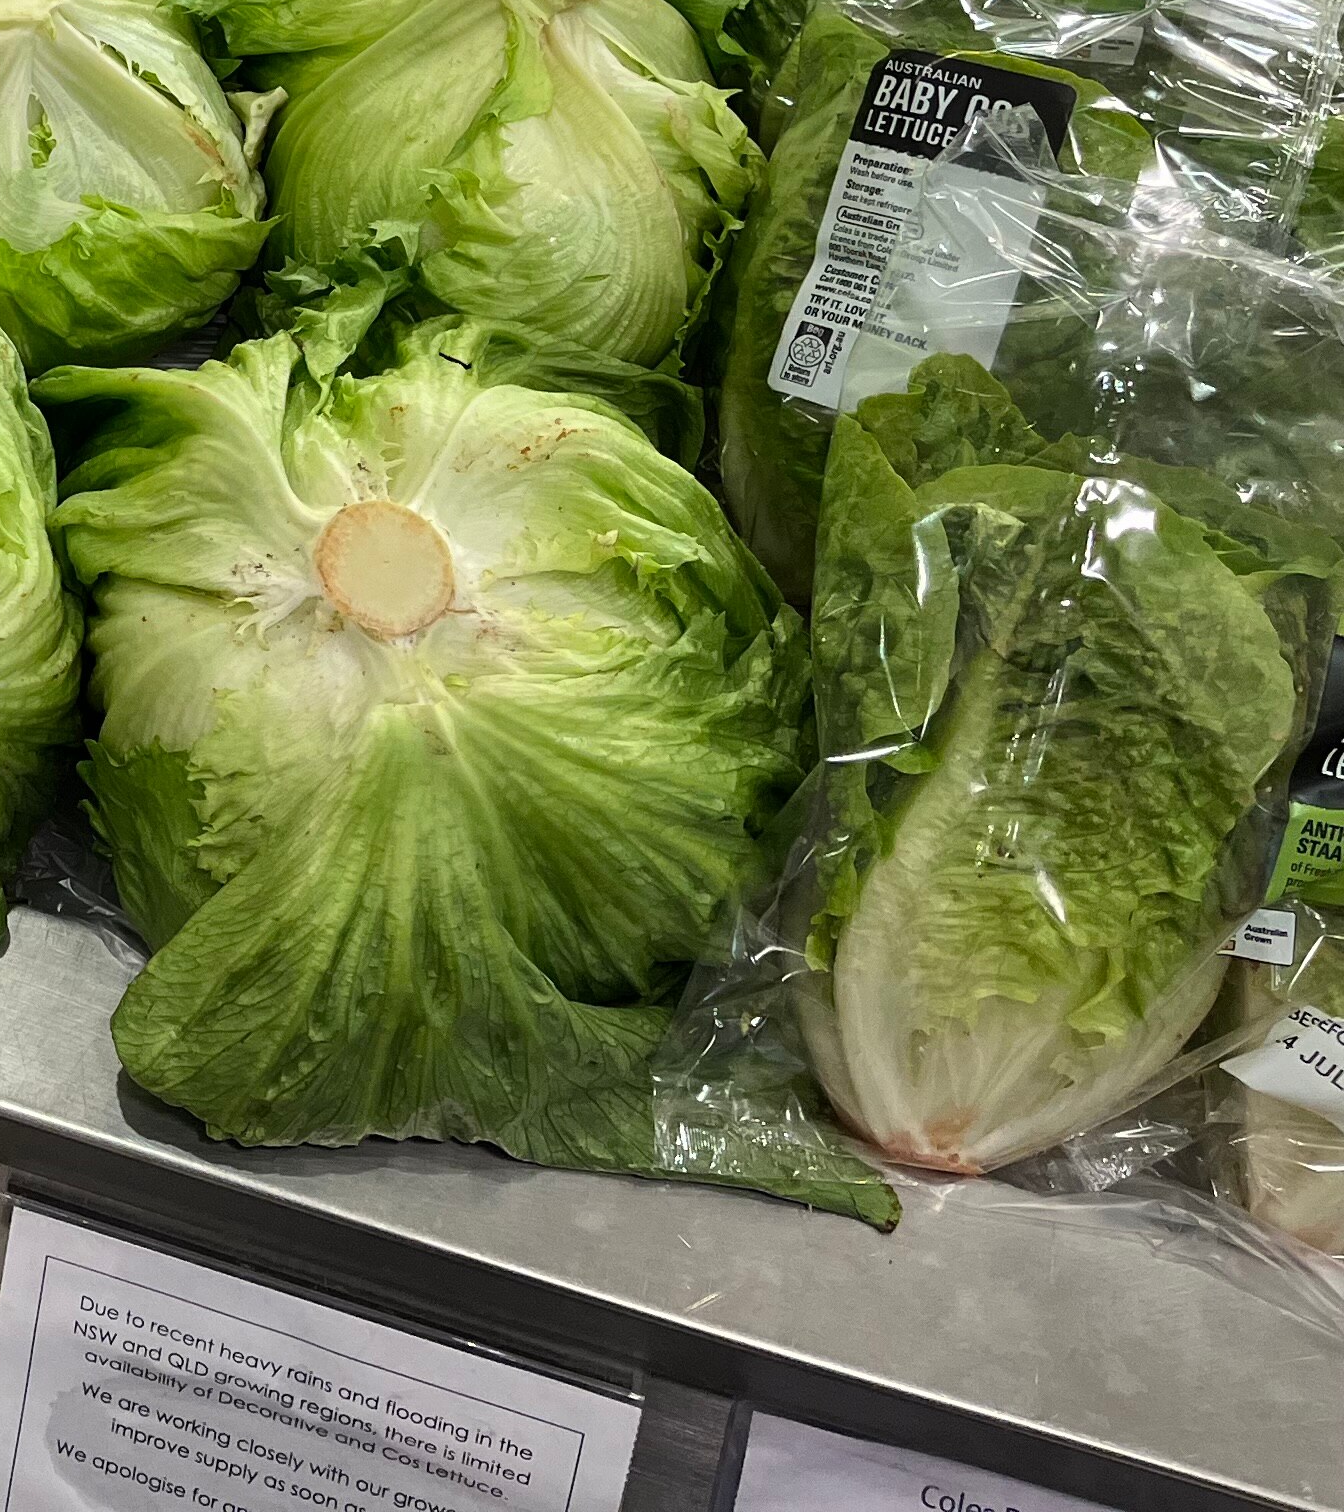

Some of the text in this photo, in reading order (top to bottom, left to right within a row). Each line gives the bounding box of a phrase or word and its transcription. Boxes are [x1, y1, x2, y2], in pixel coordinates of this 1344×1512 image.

[885, 59, 982, 90] AUSTRALIAN
[873, 75, 958, 120] BABY
[864, 109, 959, 149] LETTUCE
[850, 166, 869, 178] Wash
[871, 170, 896, 184] before
[852, 153, 914, 176] Preparation:
[846, 179, 884, 196] Storage:
[833, 223, 853, 235] Coles
[841, 210, 884, 227] Australian
[824, 264, 869, 282] Customer
[811, 293, 830, 306] TRY
[804, 305, 819, 317] OR
[822, 310, 851, 326] YOUR
[852, 318, 895, 339] MONEY
[1291, 861, 1303, 872] of
[80, 1295, 534, 1461] Due to recent heavy rains and flooding in the
[73, 1320, 118, 1346] NSW
[122, 1338, 162, 1362] and
[167, 1352, 209, 1377] QLD
[214, 1370, 295, 1409] growing
[384, 1425, 438, 1455] there
[442, 1444, 455, 1461] is
[461, 1450, 532, 1486] limited
[82, 1382, 112, 1404] We
[118, 1398, 150, 1418] are
[156, 1408, 232, 1449] working
[237, 1437, 304, 1472] closely
[309, 1462, 350, 1487] with
[356, 1479, 390, 1498] our
[84, 1350, 510, 1501] availability of Decorative and Cos Lettuce.
[56, 1439, 87, 1463] We
[92, 1455, 186, 1498] apologise
[192, 1487, 219, 1508] for
[111, 1418, 190, 1459] improve
[195, 1449, 258, 1484] supply
[264, 1476, 285, 1492] as
[290, 1484, 338, 1509] soon
[920, 1485, 994, 1512] Cole
